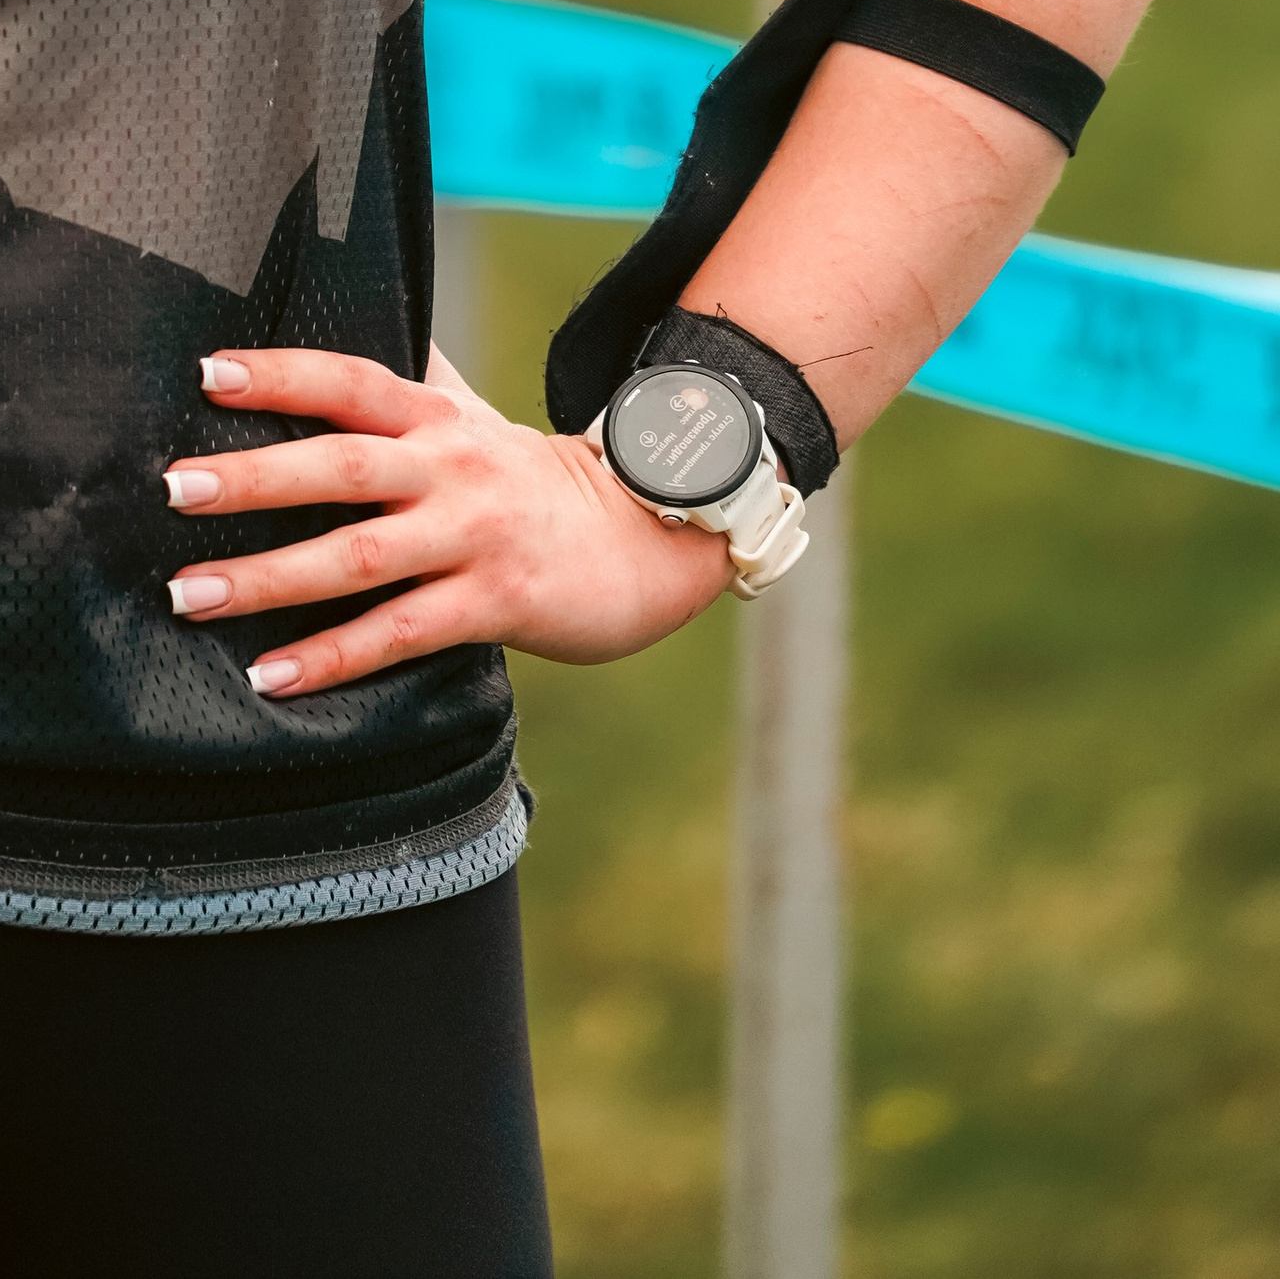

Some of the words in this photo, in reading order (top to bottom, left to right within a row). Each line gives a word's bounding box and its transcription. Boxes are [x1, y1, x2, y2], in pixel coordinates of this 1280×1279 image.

[662, 409, 717, 467] Производит.
[708, 414, 734, 441] Статус
[646, 432, 677, 464] Нагрузка
